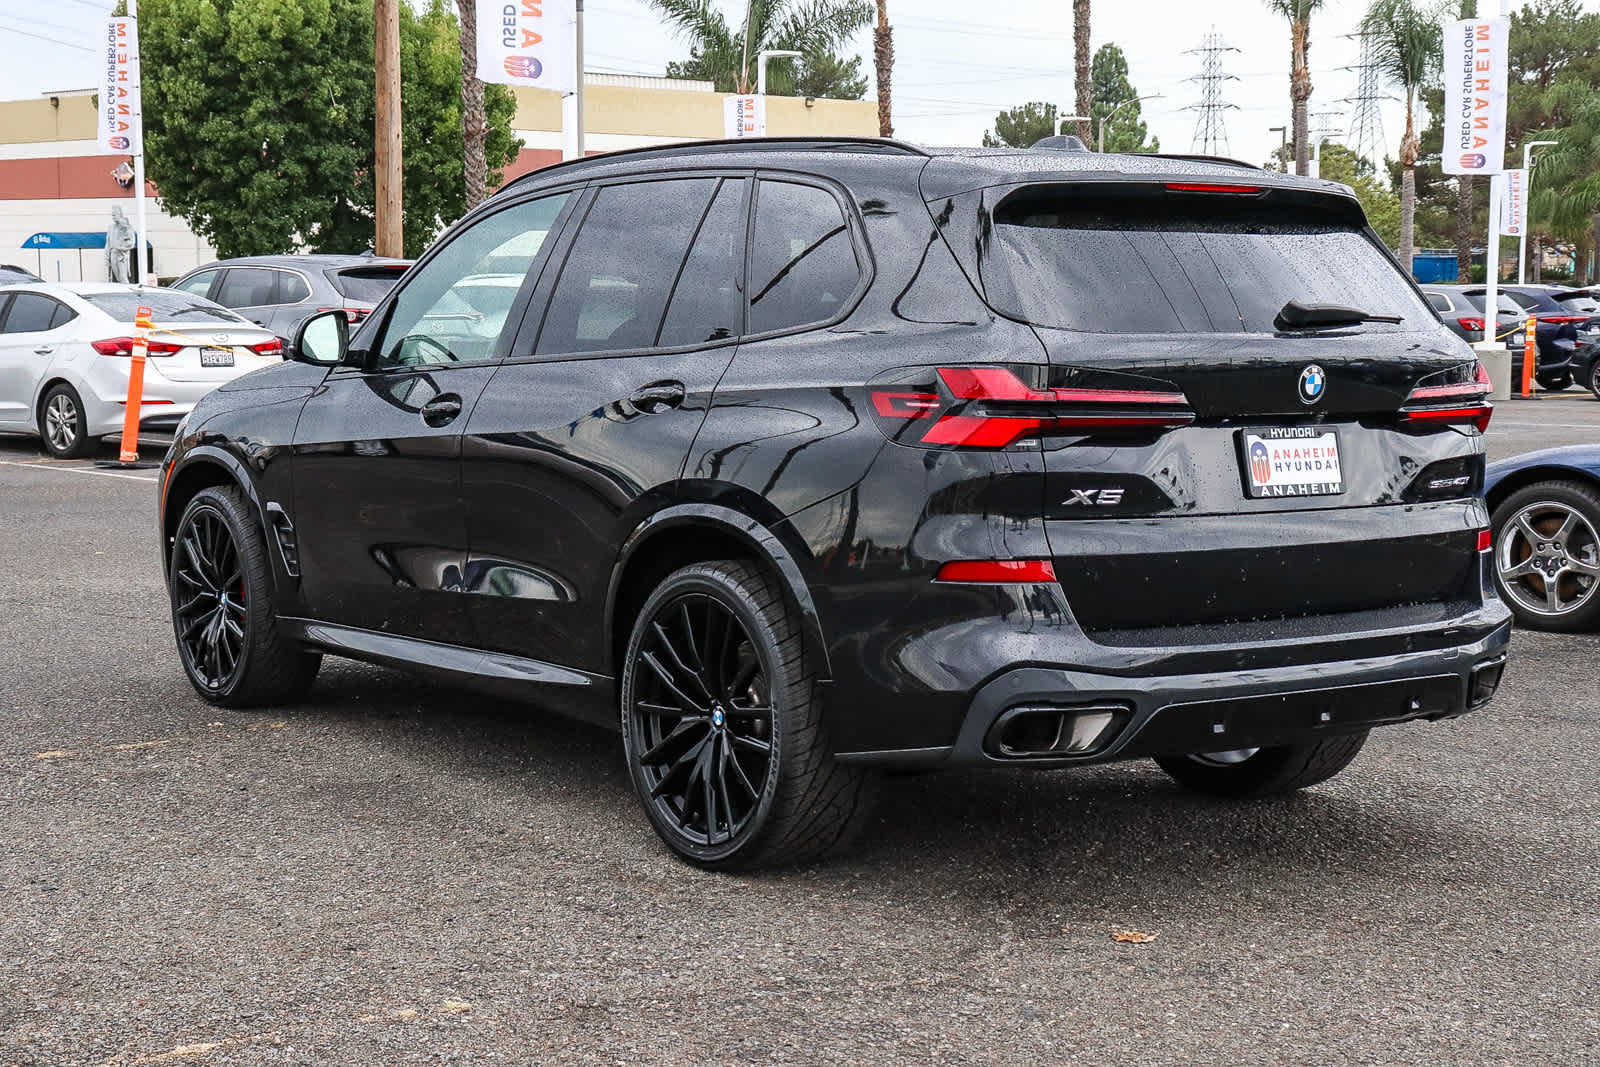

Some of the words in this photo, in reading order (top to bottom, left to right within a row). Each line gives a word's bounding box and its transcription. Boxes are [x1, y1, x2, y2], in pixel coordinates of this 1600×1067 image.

[1270, 427, 1315, 438] HYUNDAI
[1273, 447, 1337, 460] ANAHEIM
[1275, 460, 1338, 473] HYUNDAI
[1261, 483, 1341, 496] ANAHEIM
[1061, 489, 1125, 505] X5
